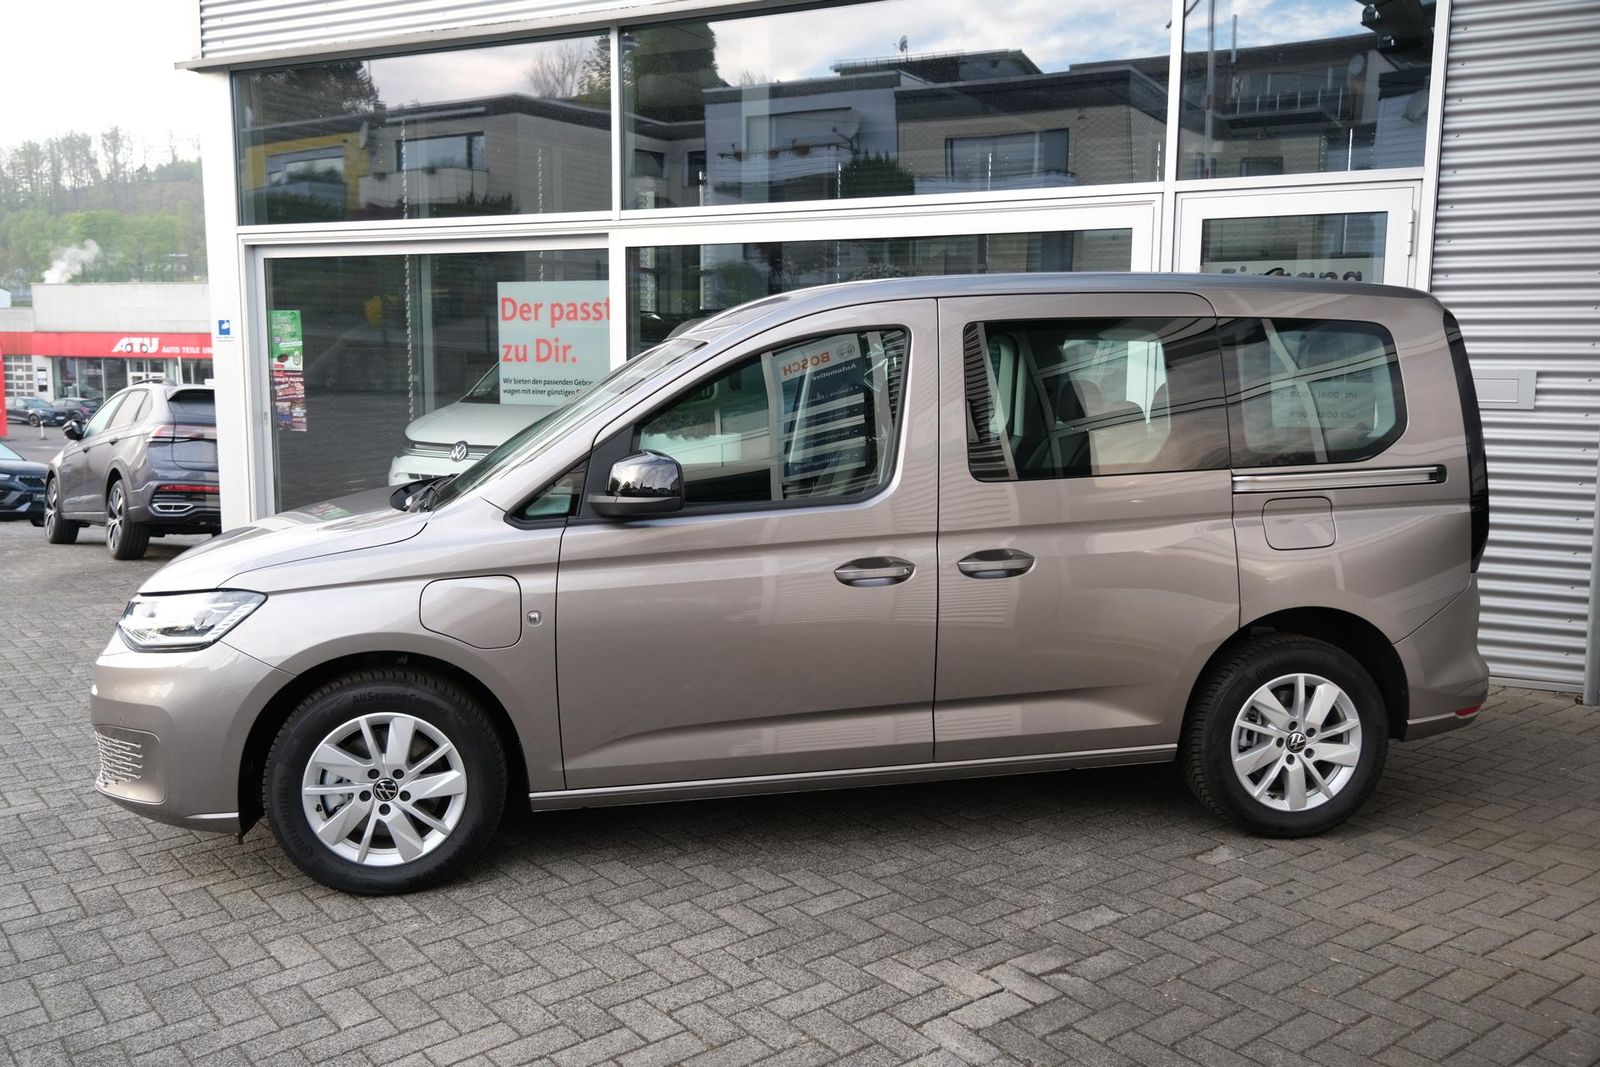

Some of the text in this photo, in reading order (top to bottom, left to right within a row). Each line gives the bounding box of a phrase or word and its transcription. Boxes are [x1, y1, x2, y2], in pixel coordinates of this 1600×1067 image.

[501, 297, 610, 329] Der passt
[161, 346, 180, 354] AUTO
[181, 346, 200, 354] TEILE
[502, 337, 577, 363] zu Dir.
[513, 377, 531, 385] bieten
[532, 377, 543, 385] den
[543, 378, 573, 386] passenden
[502, 388, 521, 396] wagen
[546, 388, 576, 397] günstigen
